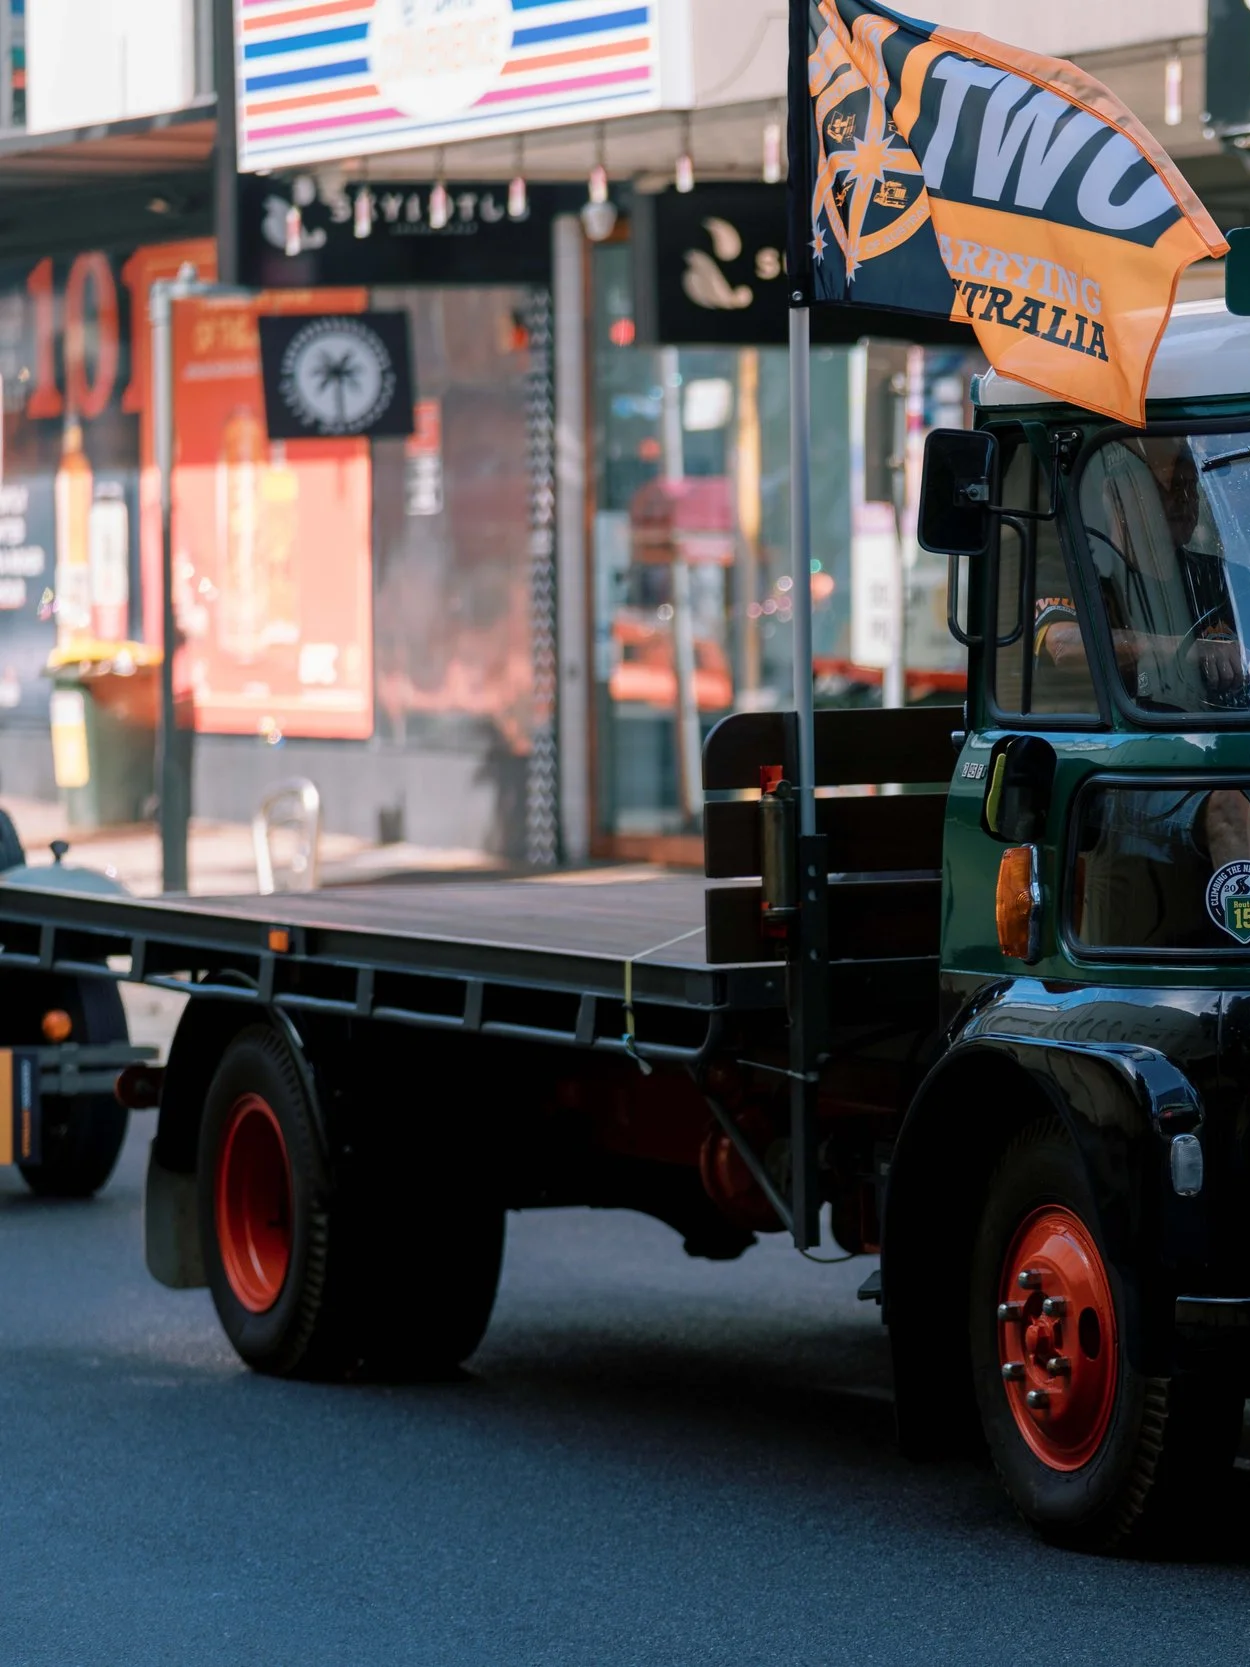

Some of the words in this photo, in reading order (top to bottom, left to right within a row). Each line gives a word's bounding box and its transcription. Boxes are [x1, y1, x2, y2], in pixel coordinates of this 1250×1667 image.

[922, 55, 1178, 230] TWU
[940, 234, 1102, 316] ARRYING
[951, 278, 1109, 362] TRALIA
[1210, 872, 1228, 907] CLIMBING
[1226, 864, 1242, 876] THE
